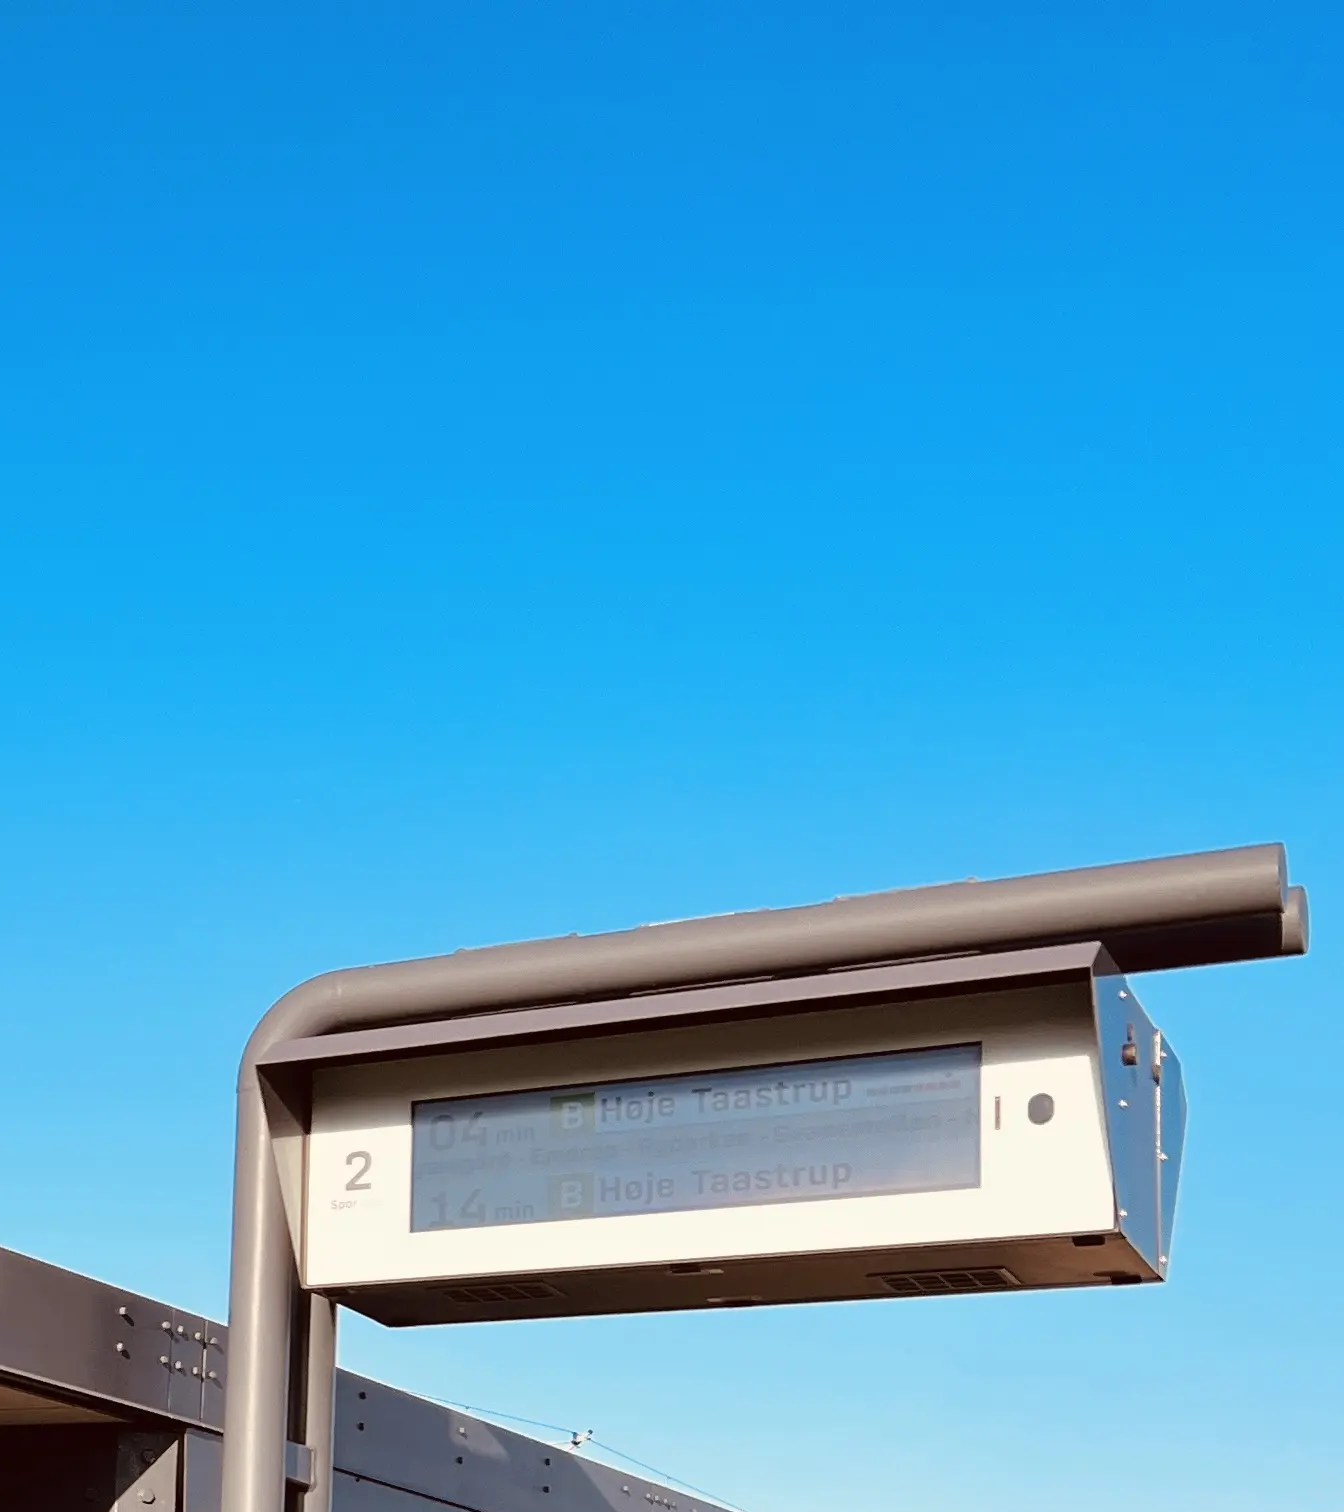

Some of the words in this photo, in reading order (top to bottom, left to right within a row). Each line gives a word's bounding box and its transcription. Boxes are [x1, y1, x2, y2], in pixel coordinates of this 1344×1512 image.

[429, 1111, 488, 1151] 04
[496, 1127, 535, 1145] min
[561, 1101, 585, 1130] B
[600, 1091, 675, 1123] Høje
[691, 1079, 853, 1114] Taastrup
[345, 1150, 372, 1191] 2
[429, 1188, 487, 1228] 14
[494, 1202, 535, 1221] min
[561, 1180, 585, 1209] B
[599, 1172, 675, 1205] Høje
[691, 1162, 853, 1195] Taastrup
[330, 1200, 358, 1211] Spor
